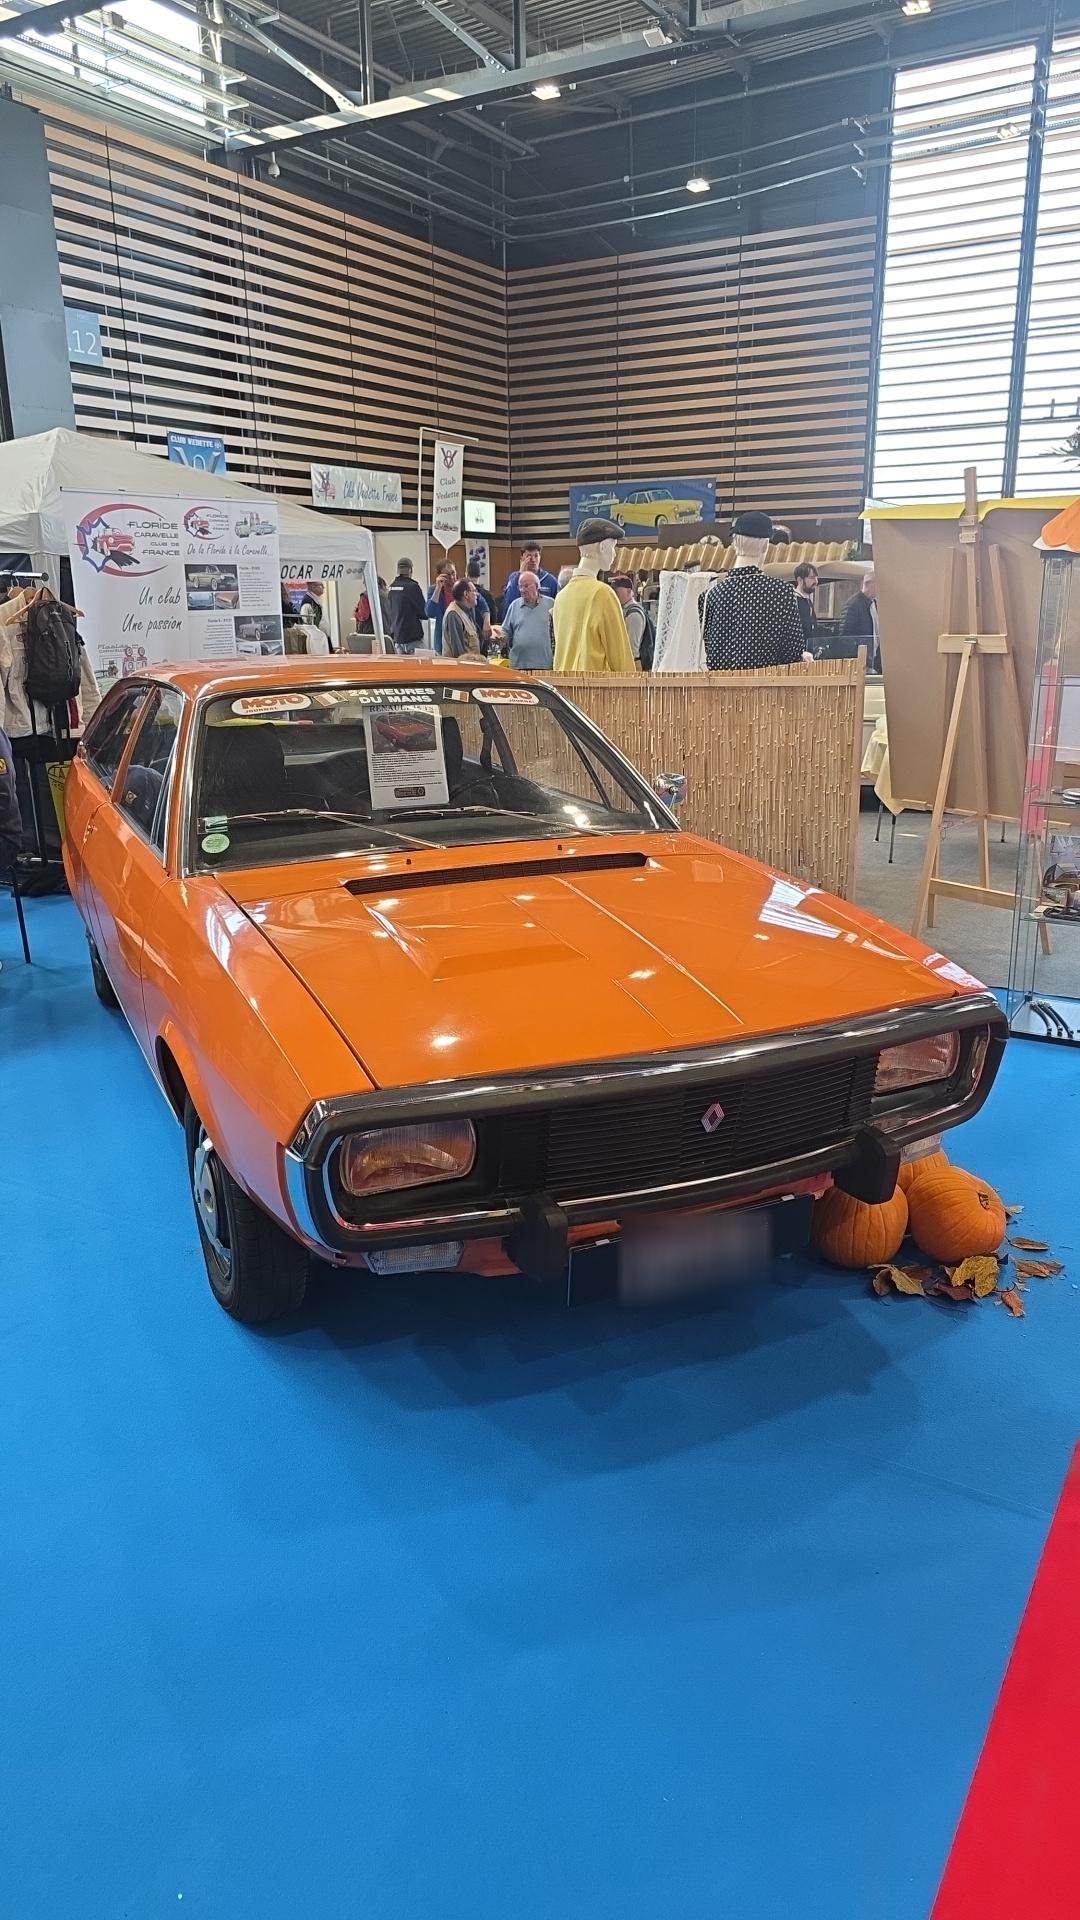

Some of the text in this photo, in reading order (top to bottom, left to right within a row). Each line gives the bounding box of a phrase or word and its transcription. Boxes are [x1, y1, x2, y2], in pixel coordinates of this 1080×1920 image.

[170, 435, 214, 448] CLUB VEDETTE
[440, 477, 457, 486] Club
[436, 491, 460, 501] Vedette
[436, 505, 459, 514] France
[134, 531, 179, 539] CARAVELLE
[187, 543, 196, 555] De
[198, 543, 205, 554] la
[206, 543, 226, 555] Floride
[234, 545, 240, 555] la
[280, 564, 344, 580] OCAR BAR
[138, 586, 181, 606] Un club
[122, 613, 183, 639] Une passion
[348, 687, 436, 697] 24 HEURES
[479, 689, 533, 700] MOTO
[240, 694, 304, 710] MOTO
[359, 695, 433, 704] DU MANS
[245, 706, 279, 714] JOURNAL
